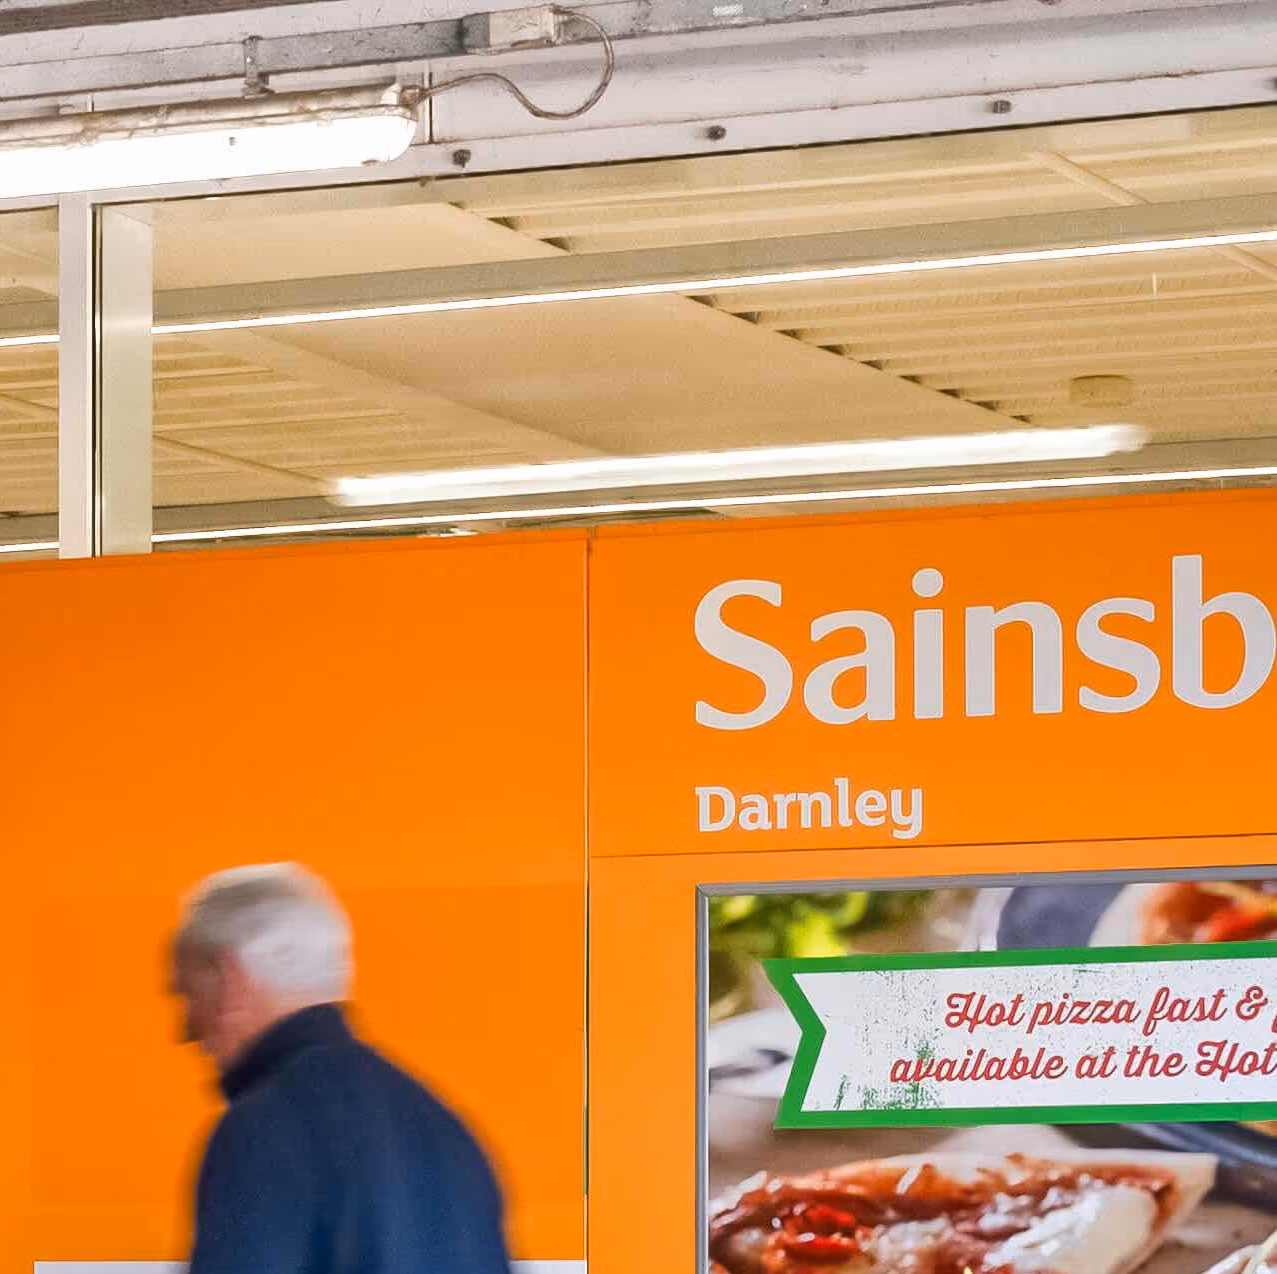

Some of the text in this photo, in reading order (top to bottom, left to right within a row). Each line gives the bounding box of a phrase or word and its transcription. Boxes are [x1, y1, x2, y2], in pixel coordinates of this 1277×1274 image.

[694, 554, 1277, 730] Sainsb
[695, 777, 924, 839] Darnley
[945, 991, 1024, 1033] Hot
[1026, 992, 1140, 1035] pizza
[1142, 986, 1227, 1037] fast
[1234, 985, 1269, 1021] &
[890, 1046, 1068, 1084] available
[1075, 1045, 1117, 1079] at
[1121, 1043, 1188, 1079] the
